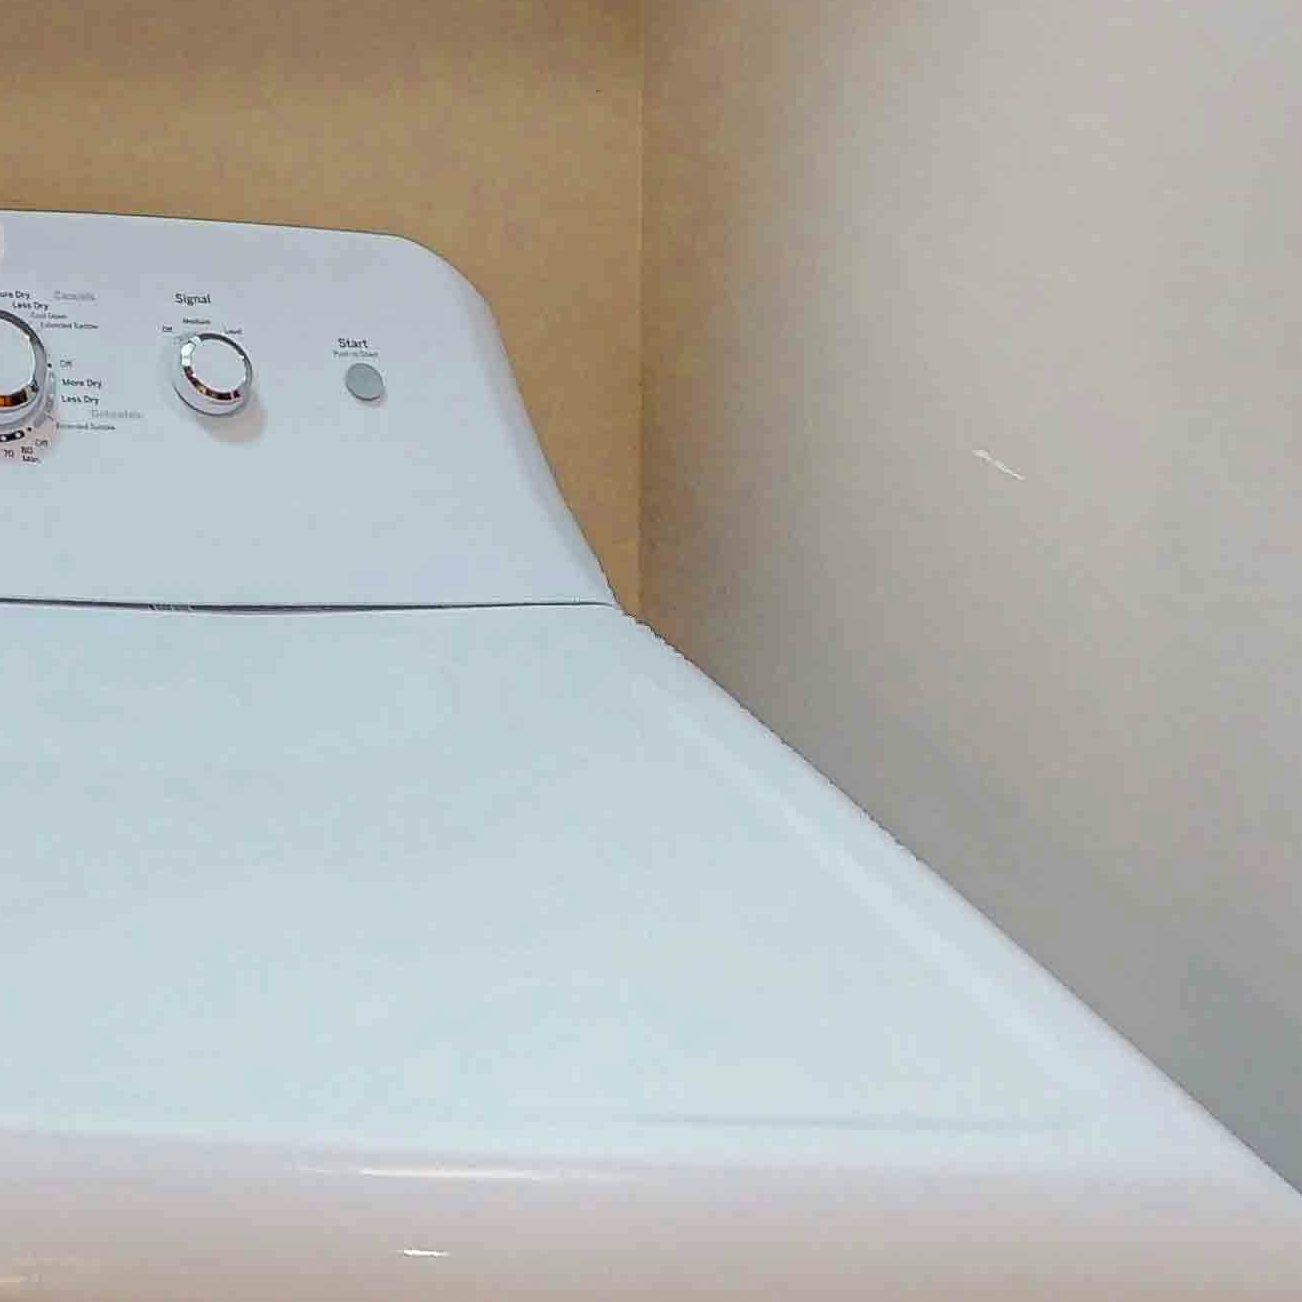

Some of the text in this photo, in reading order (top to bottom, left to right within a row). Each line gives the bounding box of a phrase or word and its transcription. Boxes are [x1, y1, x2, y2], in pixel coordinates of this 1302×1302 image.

[15, 290, 31, 300] Dry
[174, 293, 211, 306] Signal
[12, 301, 49, 311] Less Dry
[338, 337, 368, 349] Start
[62, 378, 102, 389] More Dry
[61, 395, 99, 405] Less Dry
[4, 449, 14, 458] 70
